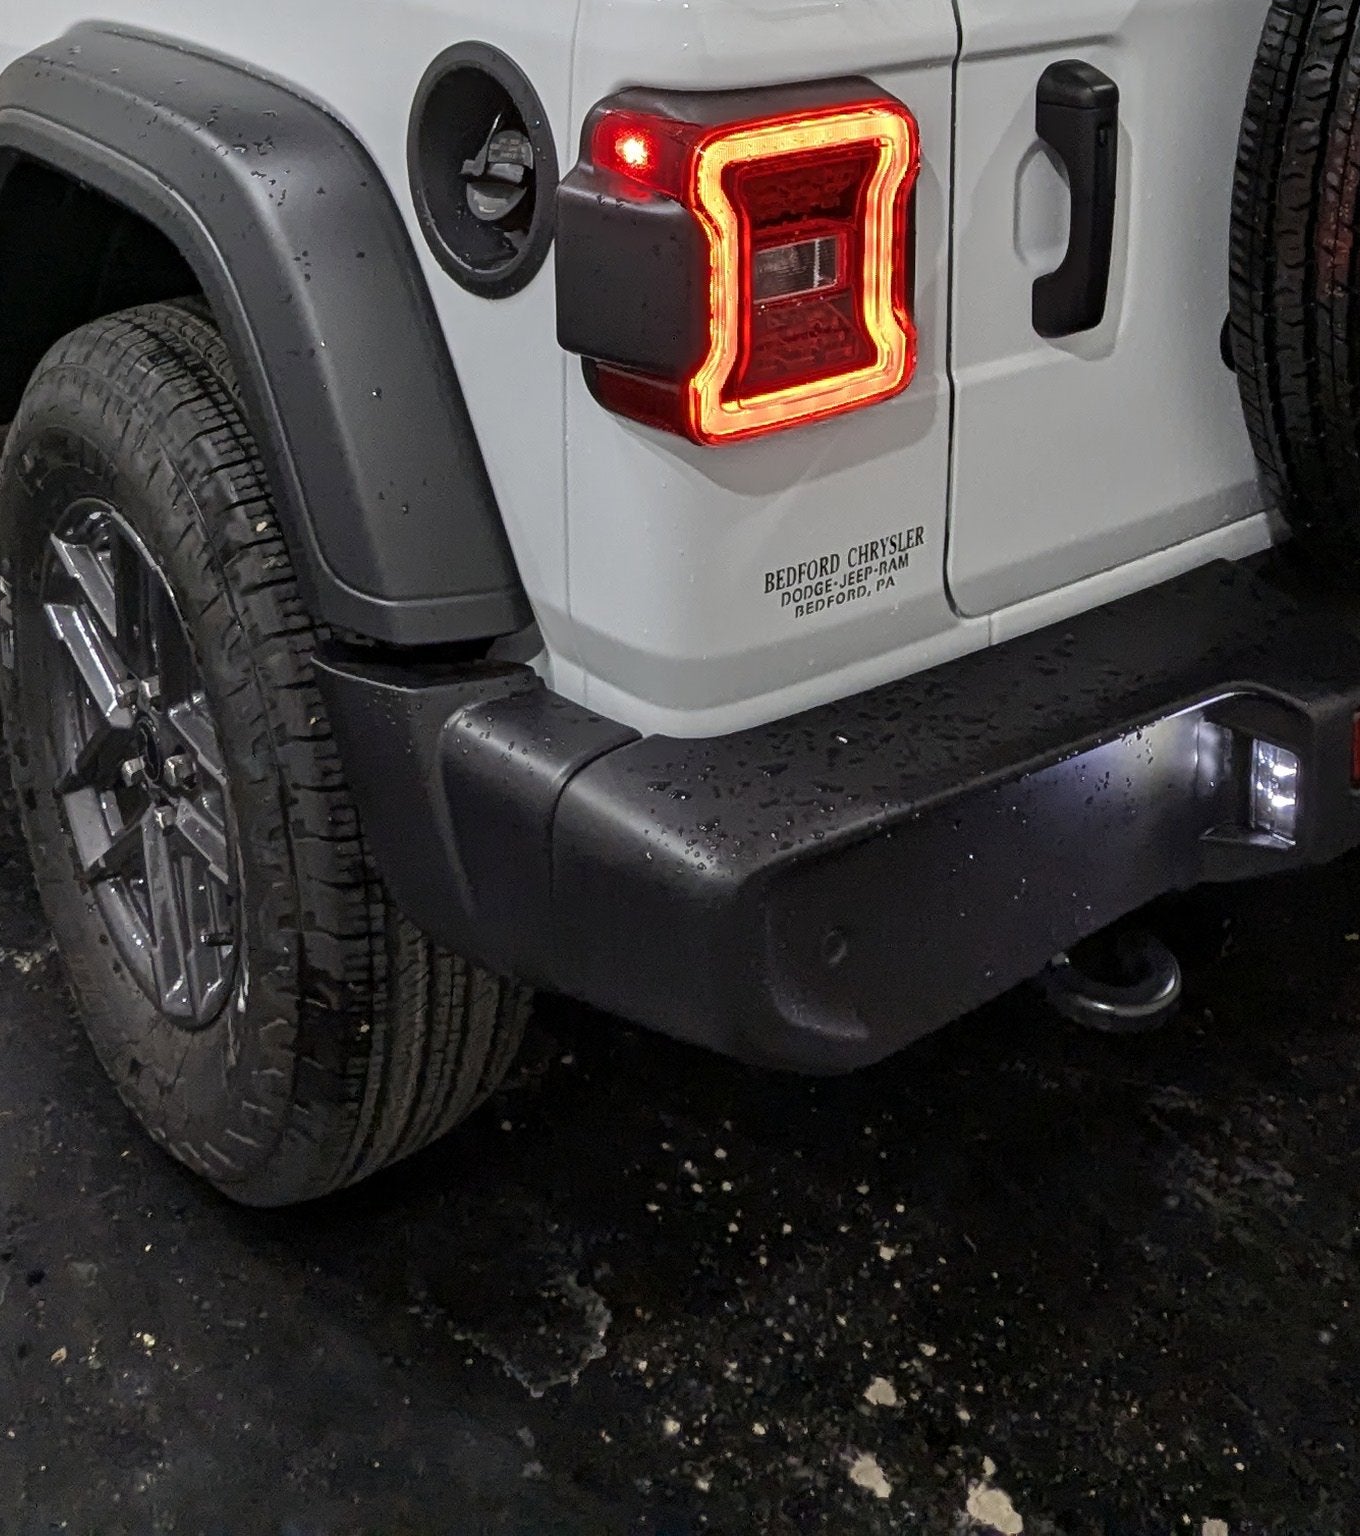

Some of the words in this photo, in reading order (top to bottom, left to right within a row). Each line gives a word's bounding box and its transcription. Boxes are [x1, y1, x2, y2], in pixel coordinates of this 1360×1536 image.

[764, 553, 840, 594] BEDFORD
[847, 525, 925, 568] CHRYSLER
[794, 585, 872, 619] BEDFORD,
[876, 575, 896, 593] PA
